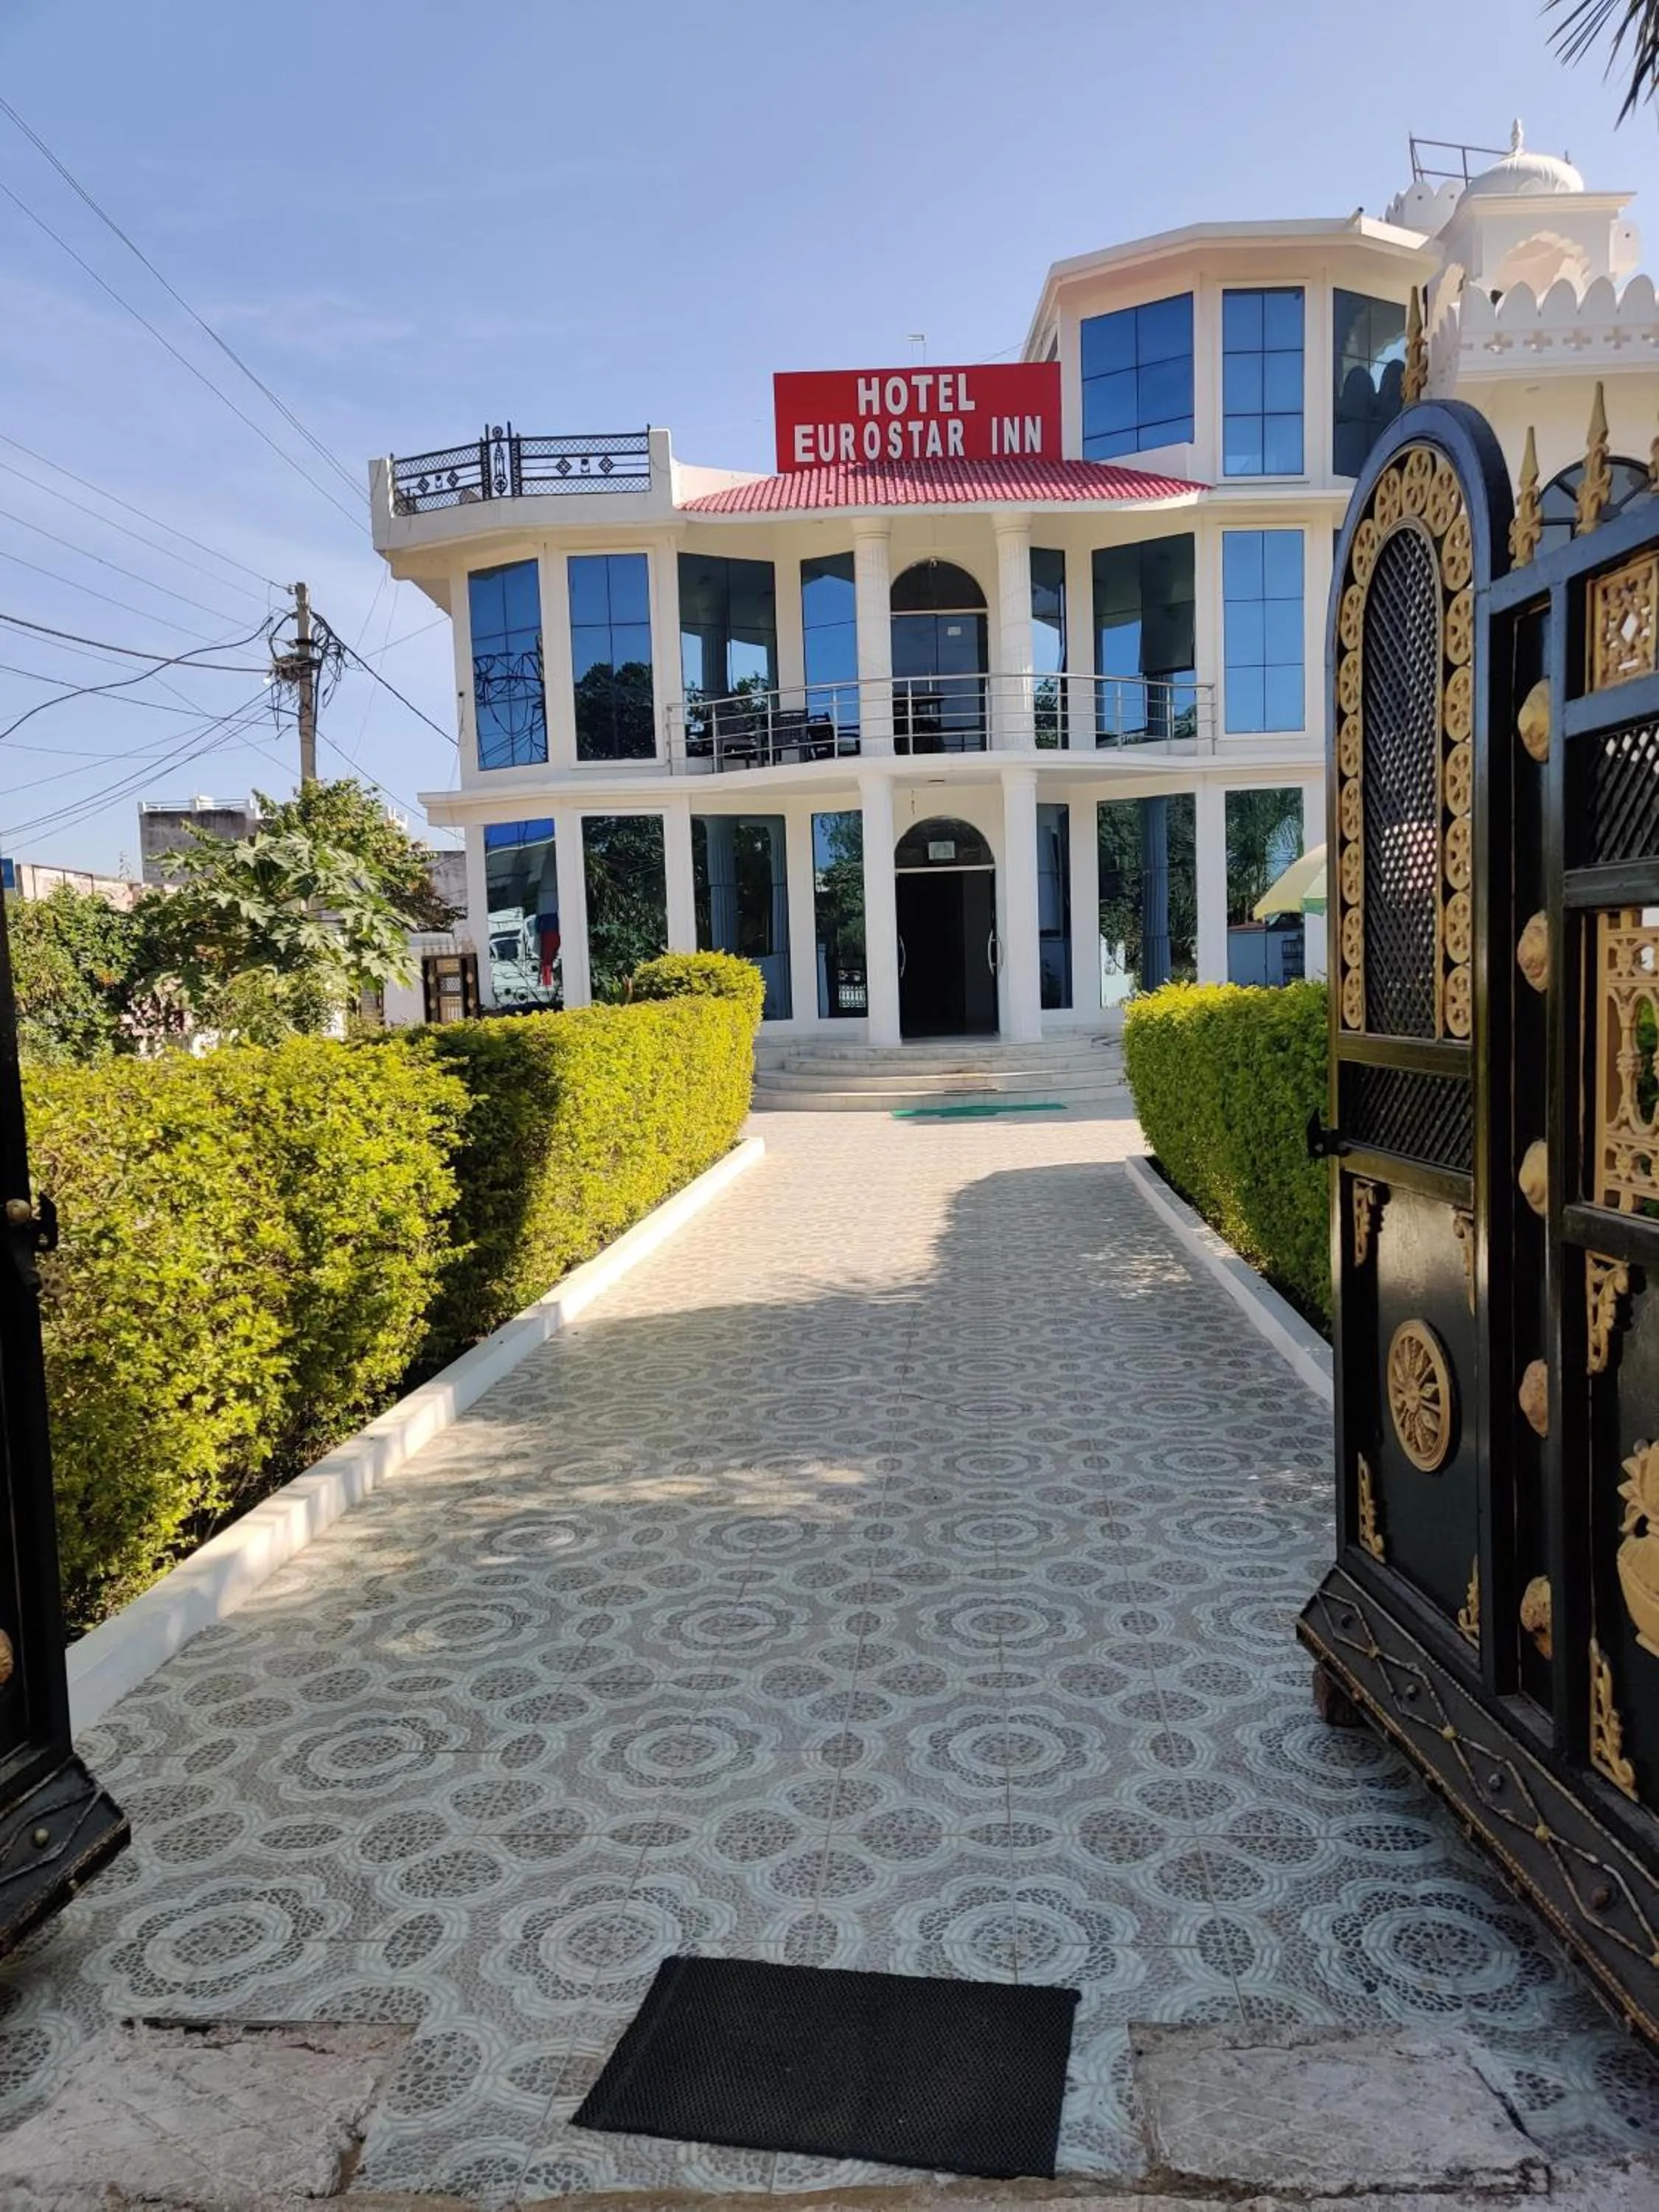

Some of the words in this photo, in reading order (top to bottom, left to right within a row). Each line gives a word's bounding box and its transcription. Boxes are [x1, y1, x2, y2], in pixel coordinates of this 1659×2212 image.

[858, 373, 975, 416] HOTEL
[793, 419, 965, 462] EUROSTAR
[991, 415, 1043, 455] INN
